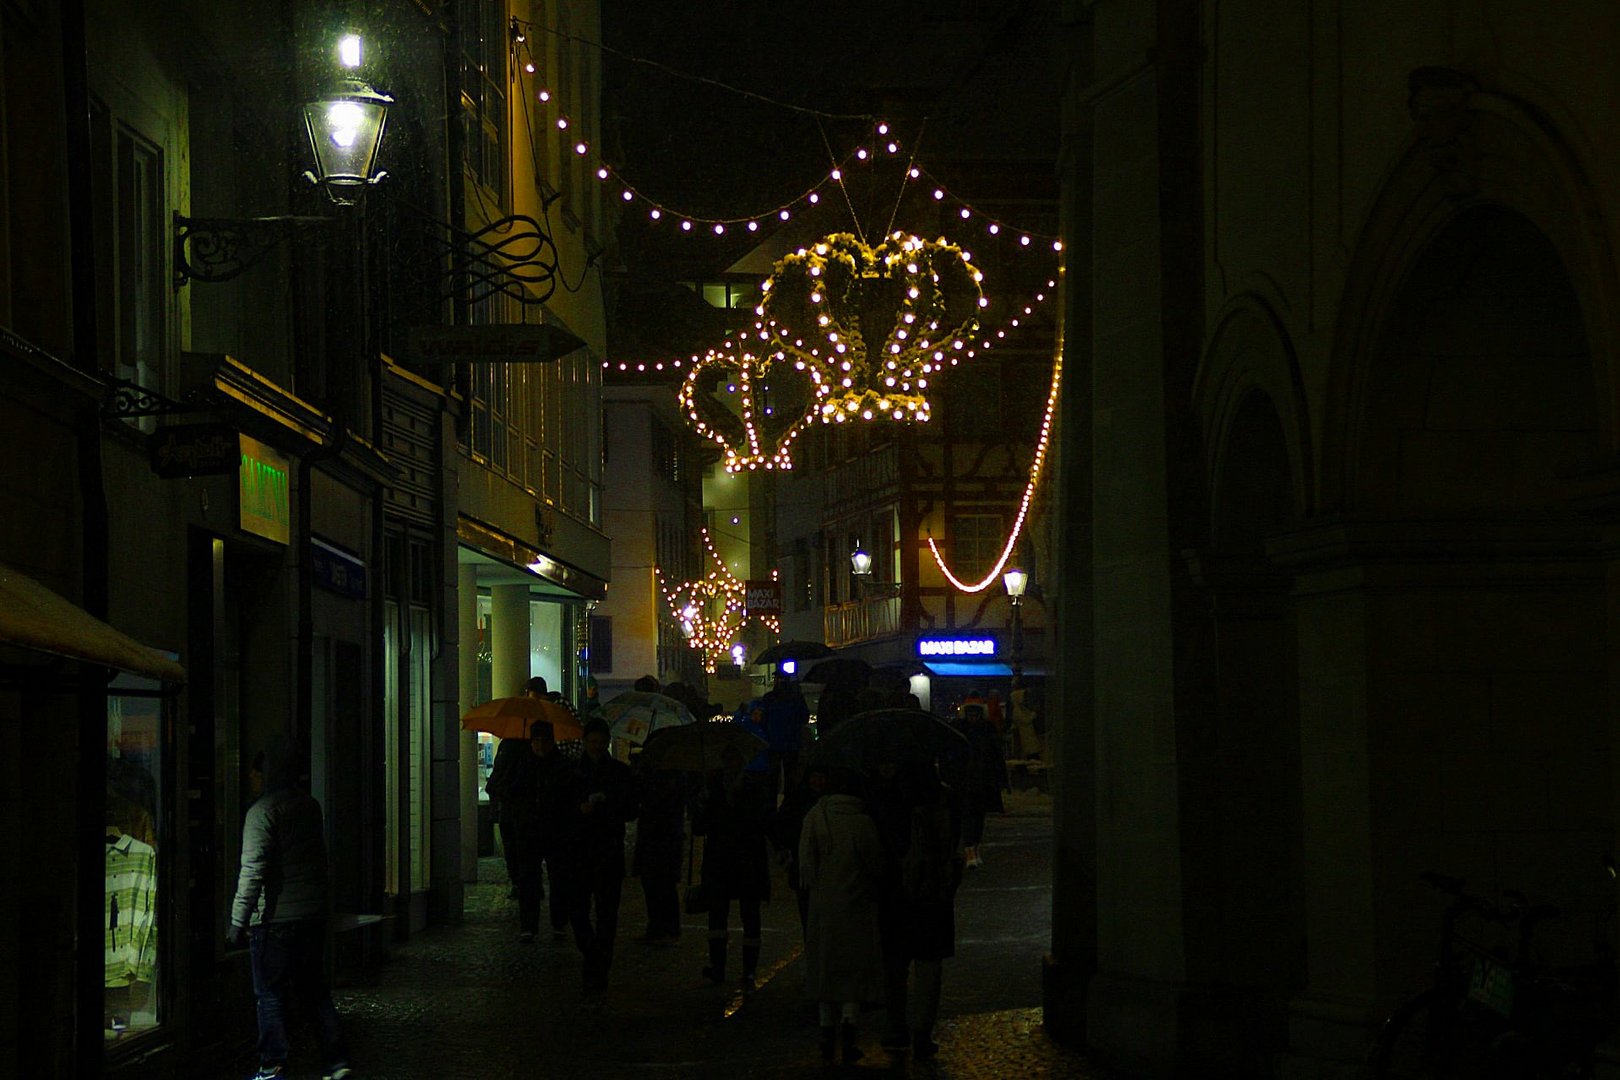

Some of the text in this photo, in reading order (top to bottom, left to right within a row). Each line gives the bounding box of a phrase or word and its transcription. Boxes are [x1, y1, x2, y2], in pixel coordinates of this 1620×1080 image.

[747, 588, 774, 598] MAXI
[747, 599, 779, 609] BAZAR
[921, 641, 994, 655] MAXI BAZAR
